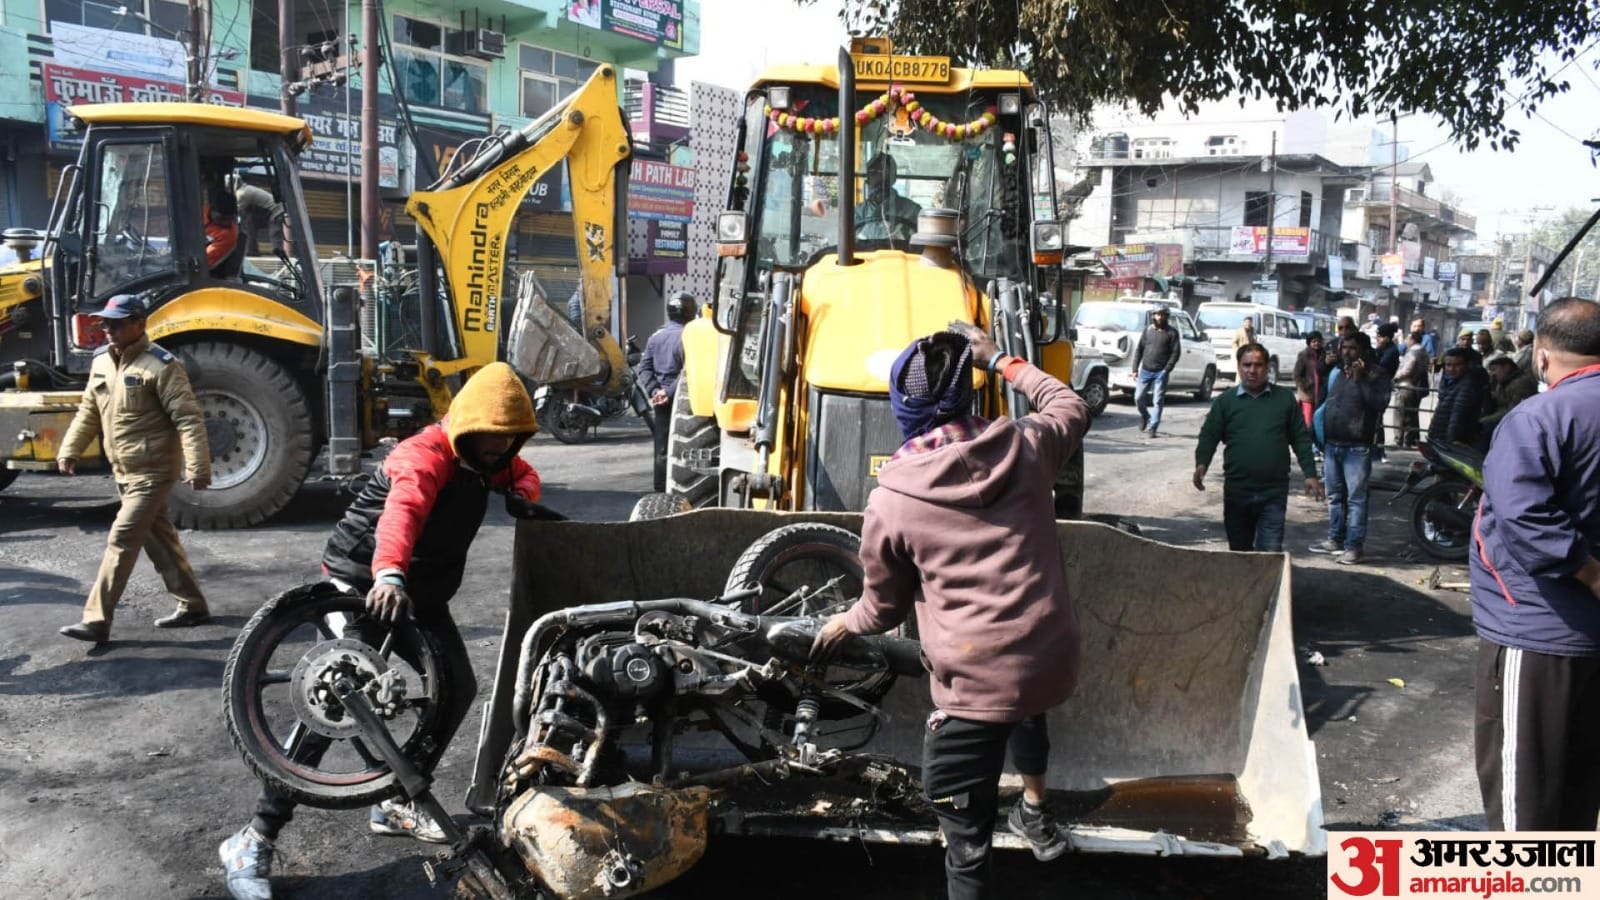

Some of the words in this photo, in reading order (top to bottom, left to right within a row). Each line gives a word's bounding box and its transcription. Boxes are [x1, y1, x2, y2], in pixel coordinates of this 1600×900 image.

[857, 61, 948, 77] UK04CB8778
[646, 164, 672, 185] PATH
[676, 168, 695, 188] LAB
